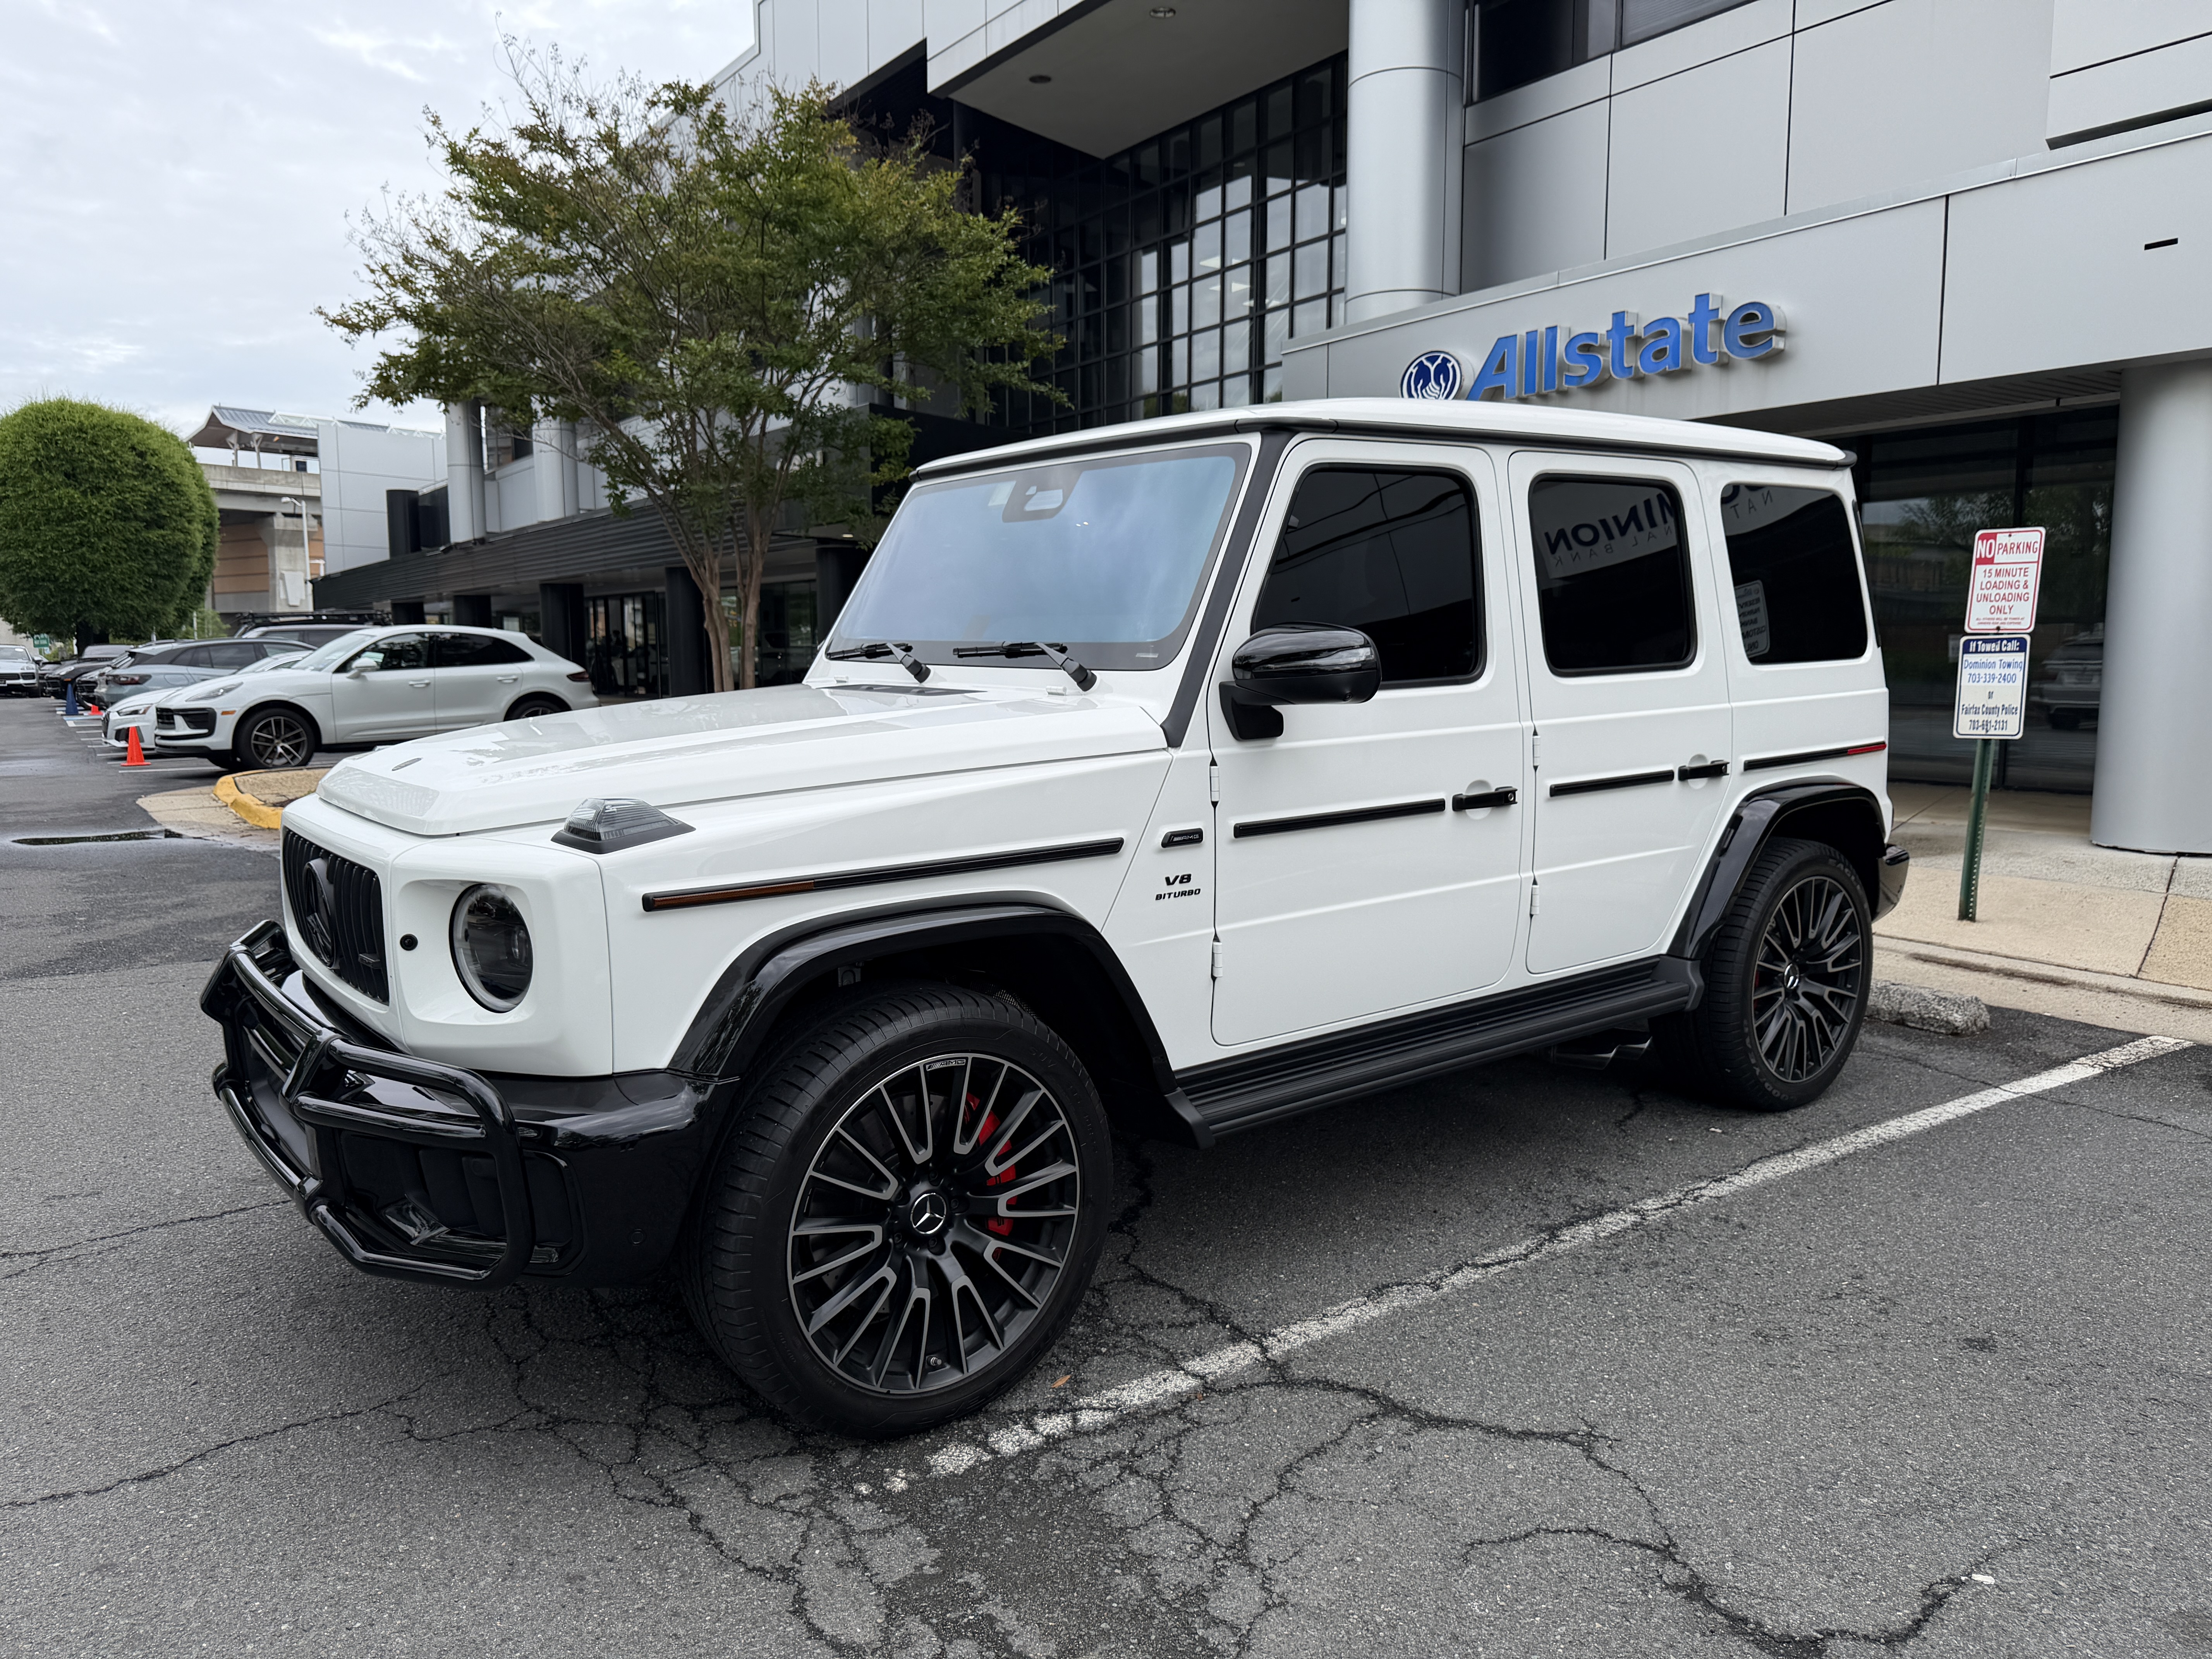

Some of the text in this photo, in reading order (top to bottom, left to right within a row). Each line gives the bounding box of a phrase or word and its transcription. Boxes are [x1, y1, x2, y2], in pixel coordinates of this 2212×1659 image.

[1465, 293, 1781, 401] Allstate
[1976, 539, 2039, 558] NO PARKING
[1983, 567, 2029, 578] 15 MINUTE
[1980, 579, 2029, 591] LOADING &
[1976, 592, 2030, 603] UNLOADING
[1989, 605, 2014, 615] ONLY
[1970, 639, 2020, 652] If Towed Call:
[1964, 658, 2023, 672] Dominion Towing
[1968, 673, 2017, 683] 703-339-2400
[1988, 691, 1994, 699] or
[1961, 704, 2019, 717] Fairfax County Police
[1165, 873, 1192, 886] V8
[1155, 888, 1201, 901] BITURBO
